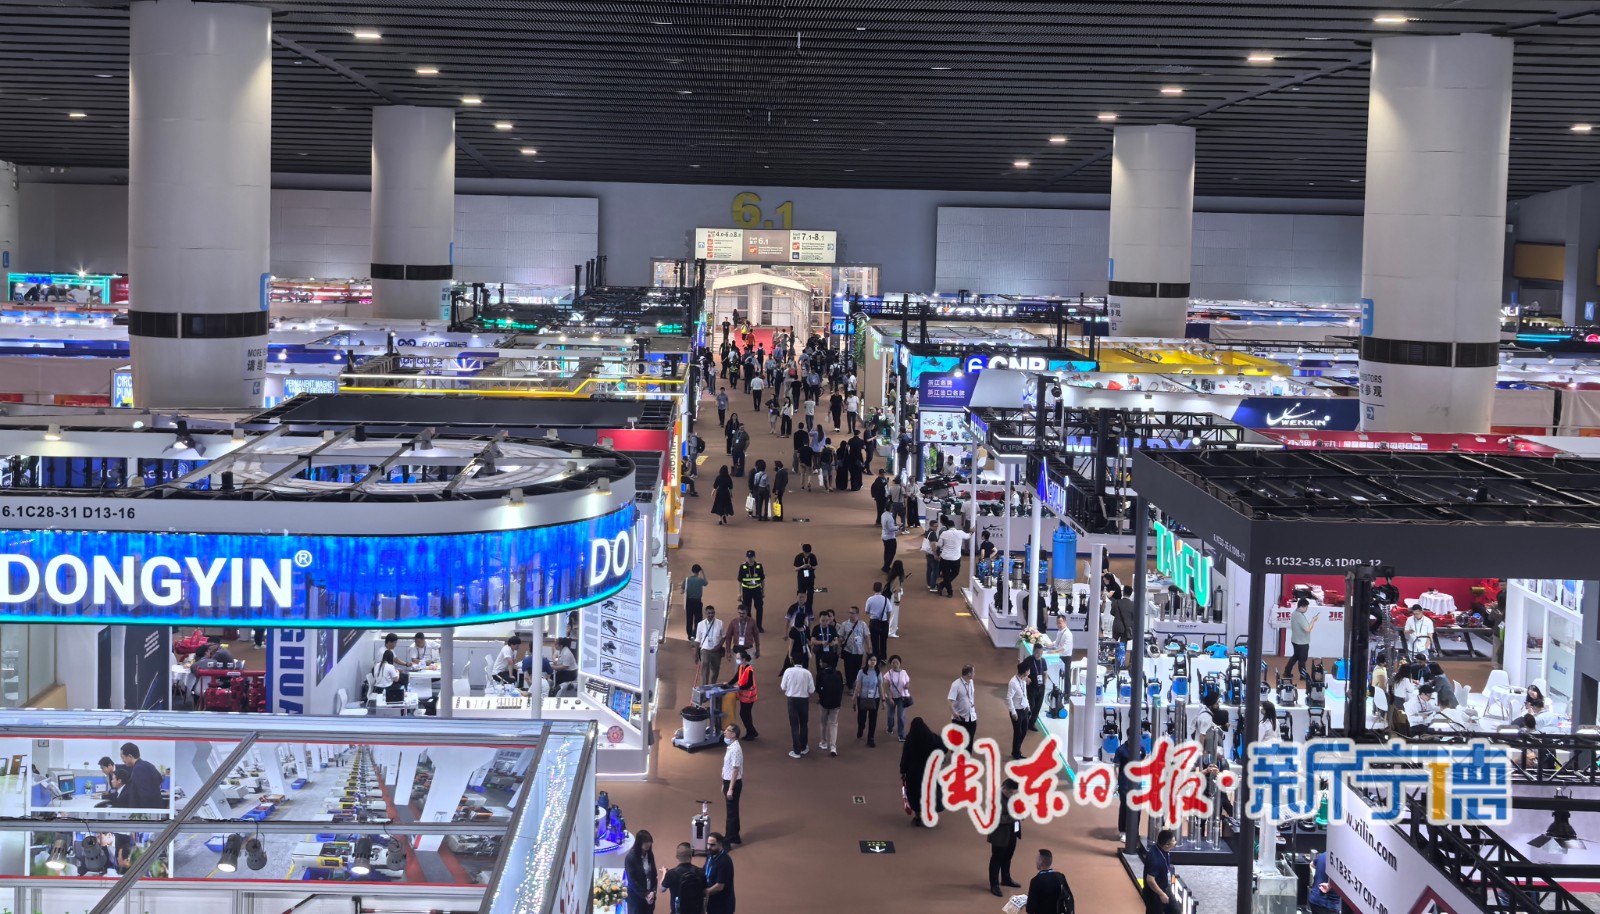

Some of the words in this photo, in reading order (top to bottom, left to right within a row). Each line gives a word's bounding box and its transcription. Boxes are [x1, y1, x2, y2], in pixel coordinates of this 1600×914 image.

[732, 191, 793, 229] 6.1
[1281, 419, 1326, 427] WENXIN
[2, 506, 78, 518] 6.1C28-31
[83, 507, 136, 519] D13-16
[0, 553, 293, 608] DONGYIN
